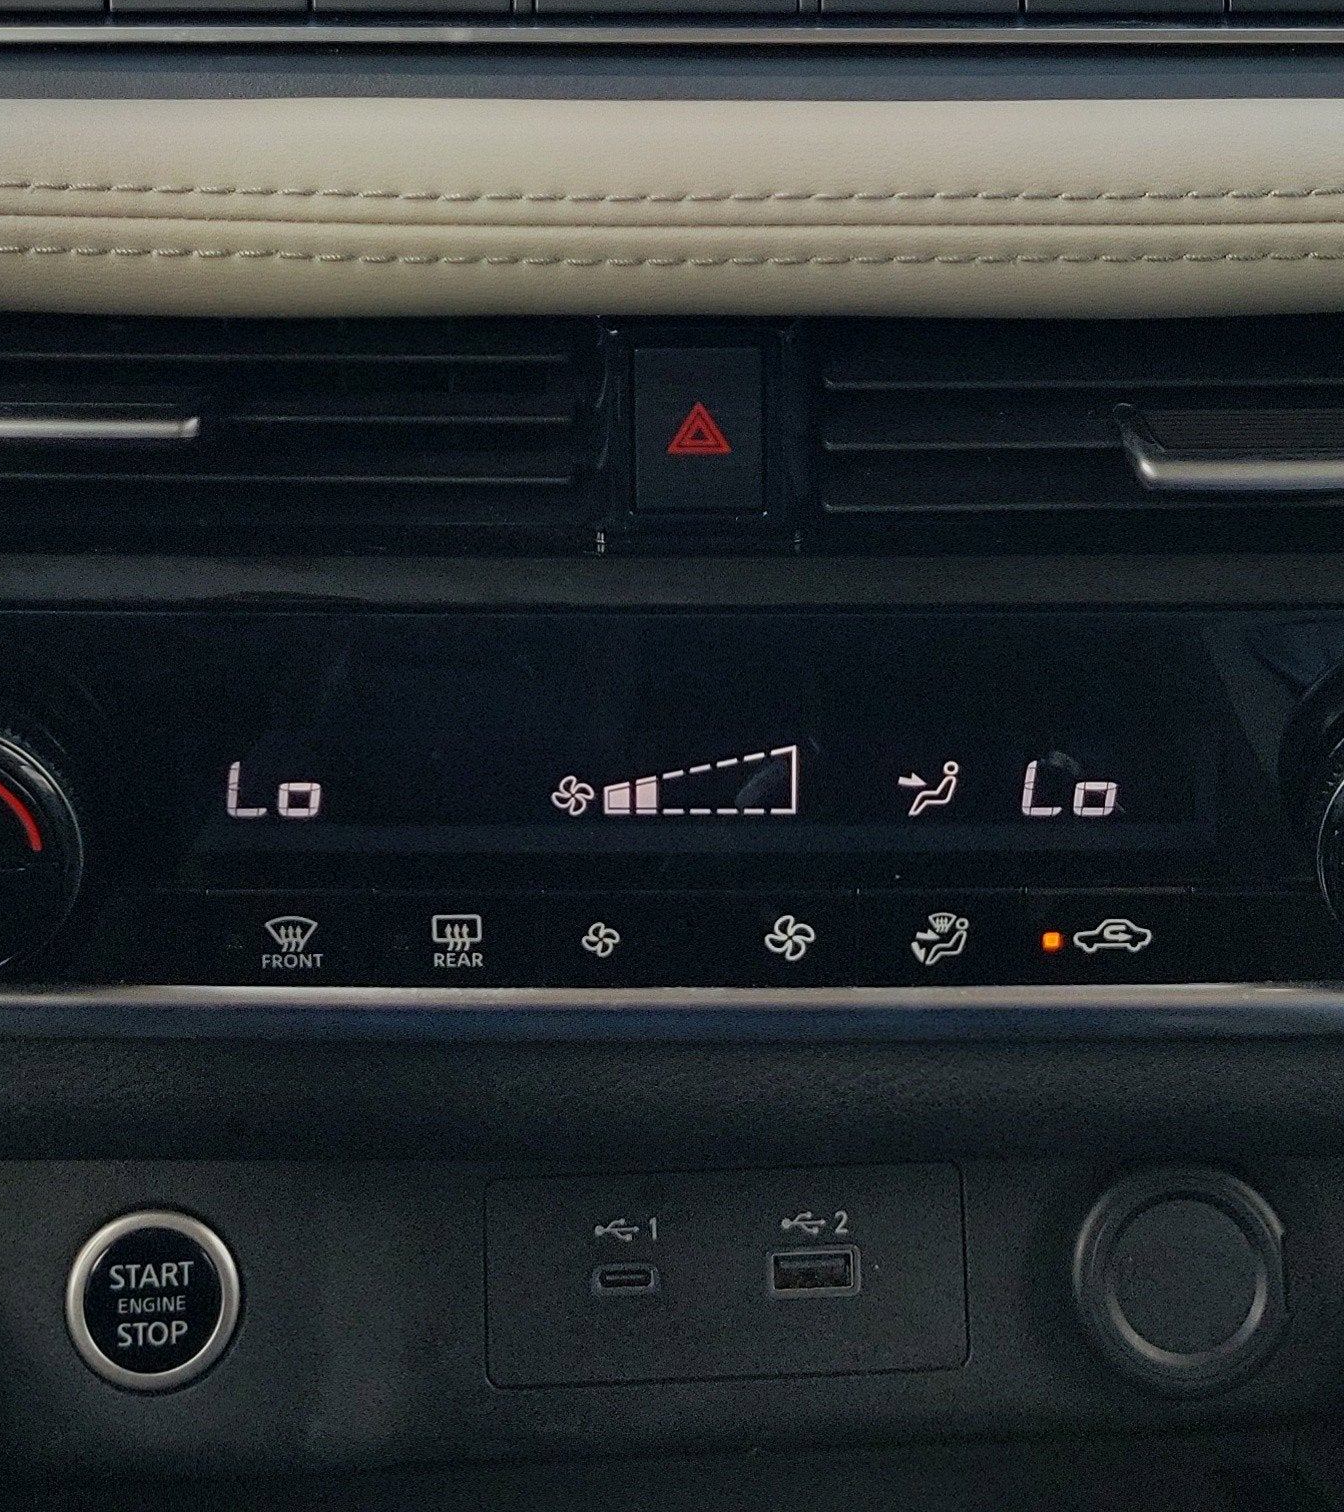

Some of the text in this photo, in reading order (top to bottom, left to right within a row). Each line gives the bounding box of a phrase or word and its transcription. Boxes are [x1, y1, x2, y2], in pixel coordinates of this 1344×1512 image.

[261, 953, 323, 969] FRONT
[434, 953, 483, 967] REAR
[834, 1210, 848, 1234] 2
[110, 1261, 193, 1289] START
[118, 1296, 185, 1314] ENGINE
[118, 1321, 188, 1347] STOP
